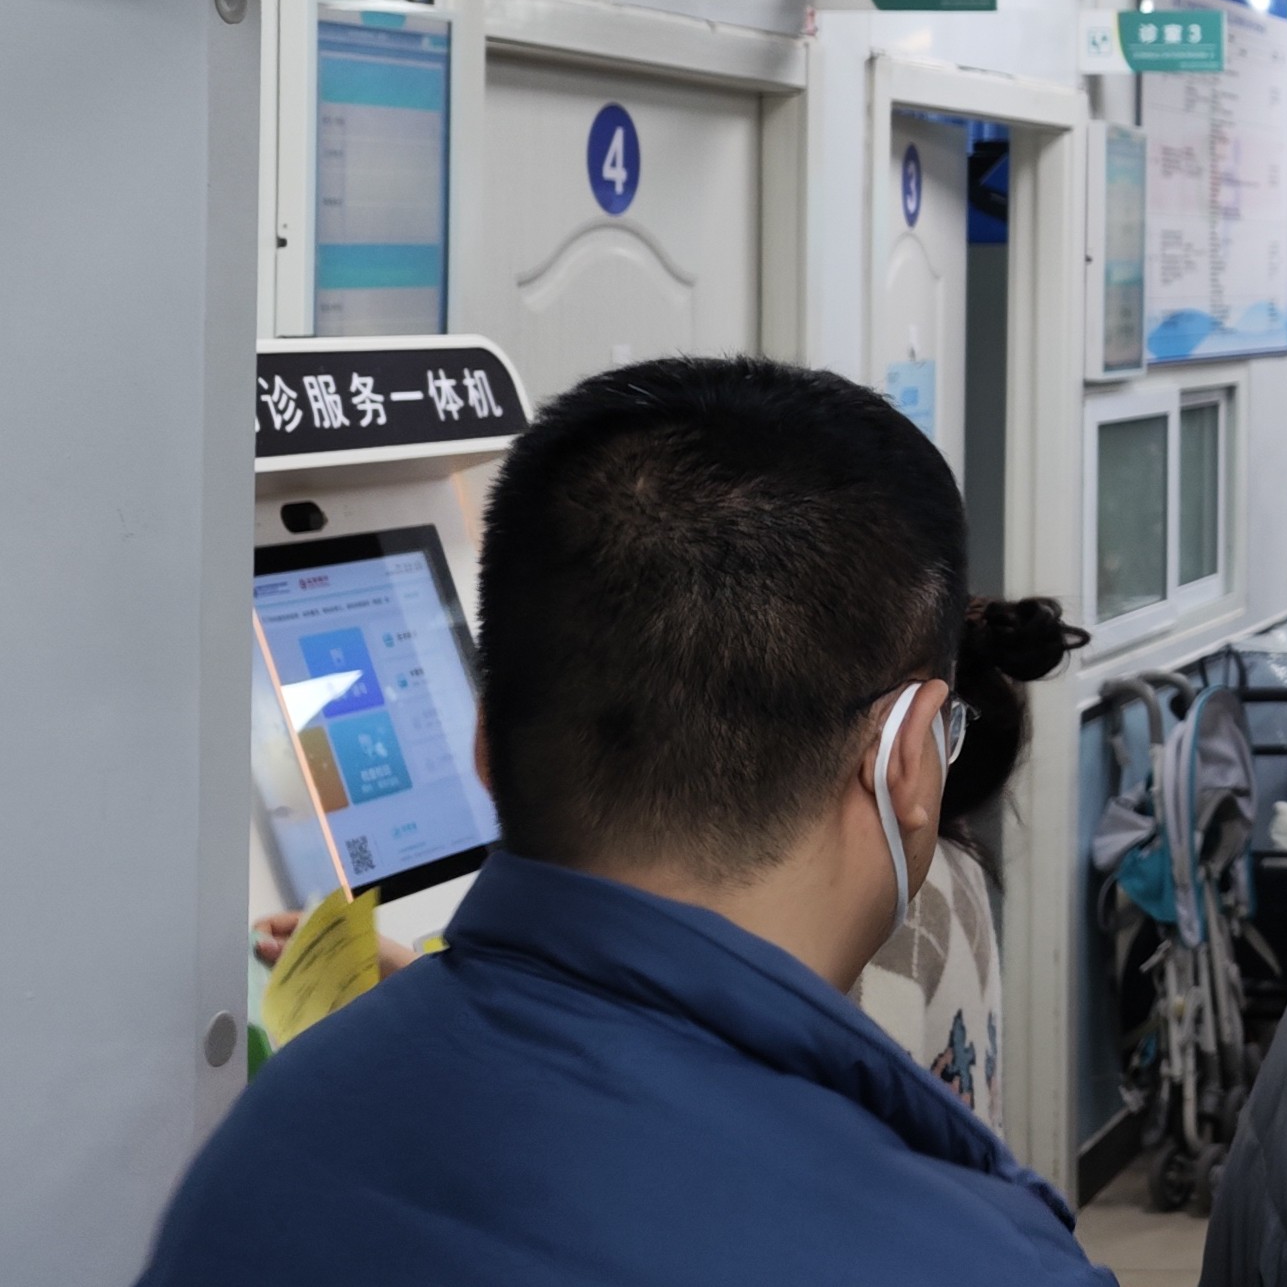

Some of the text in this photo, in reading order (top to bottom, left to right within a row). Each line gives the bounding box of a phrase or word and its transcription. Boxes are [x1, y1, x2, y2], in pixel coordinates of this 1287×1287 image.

[602, 125, 628, 195] 4
[906, 159, 918, 214] 3
[254, 368, 503, 433] 诊服务一体机
